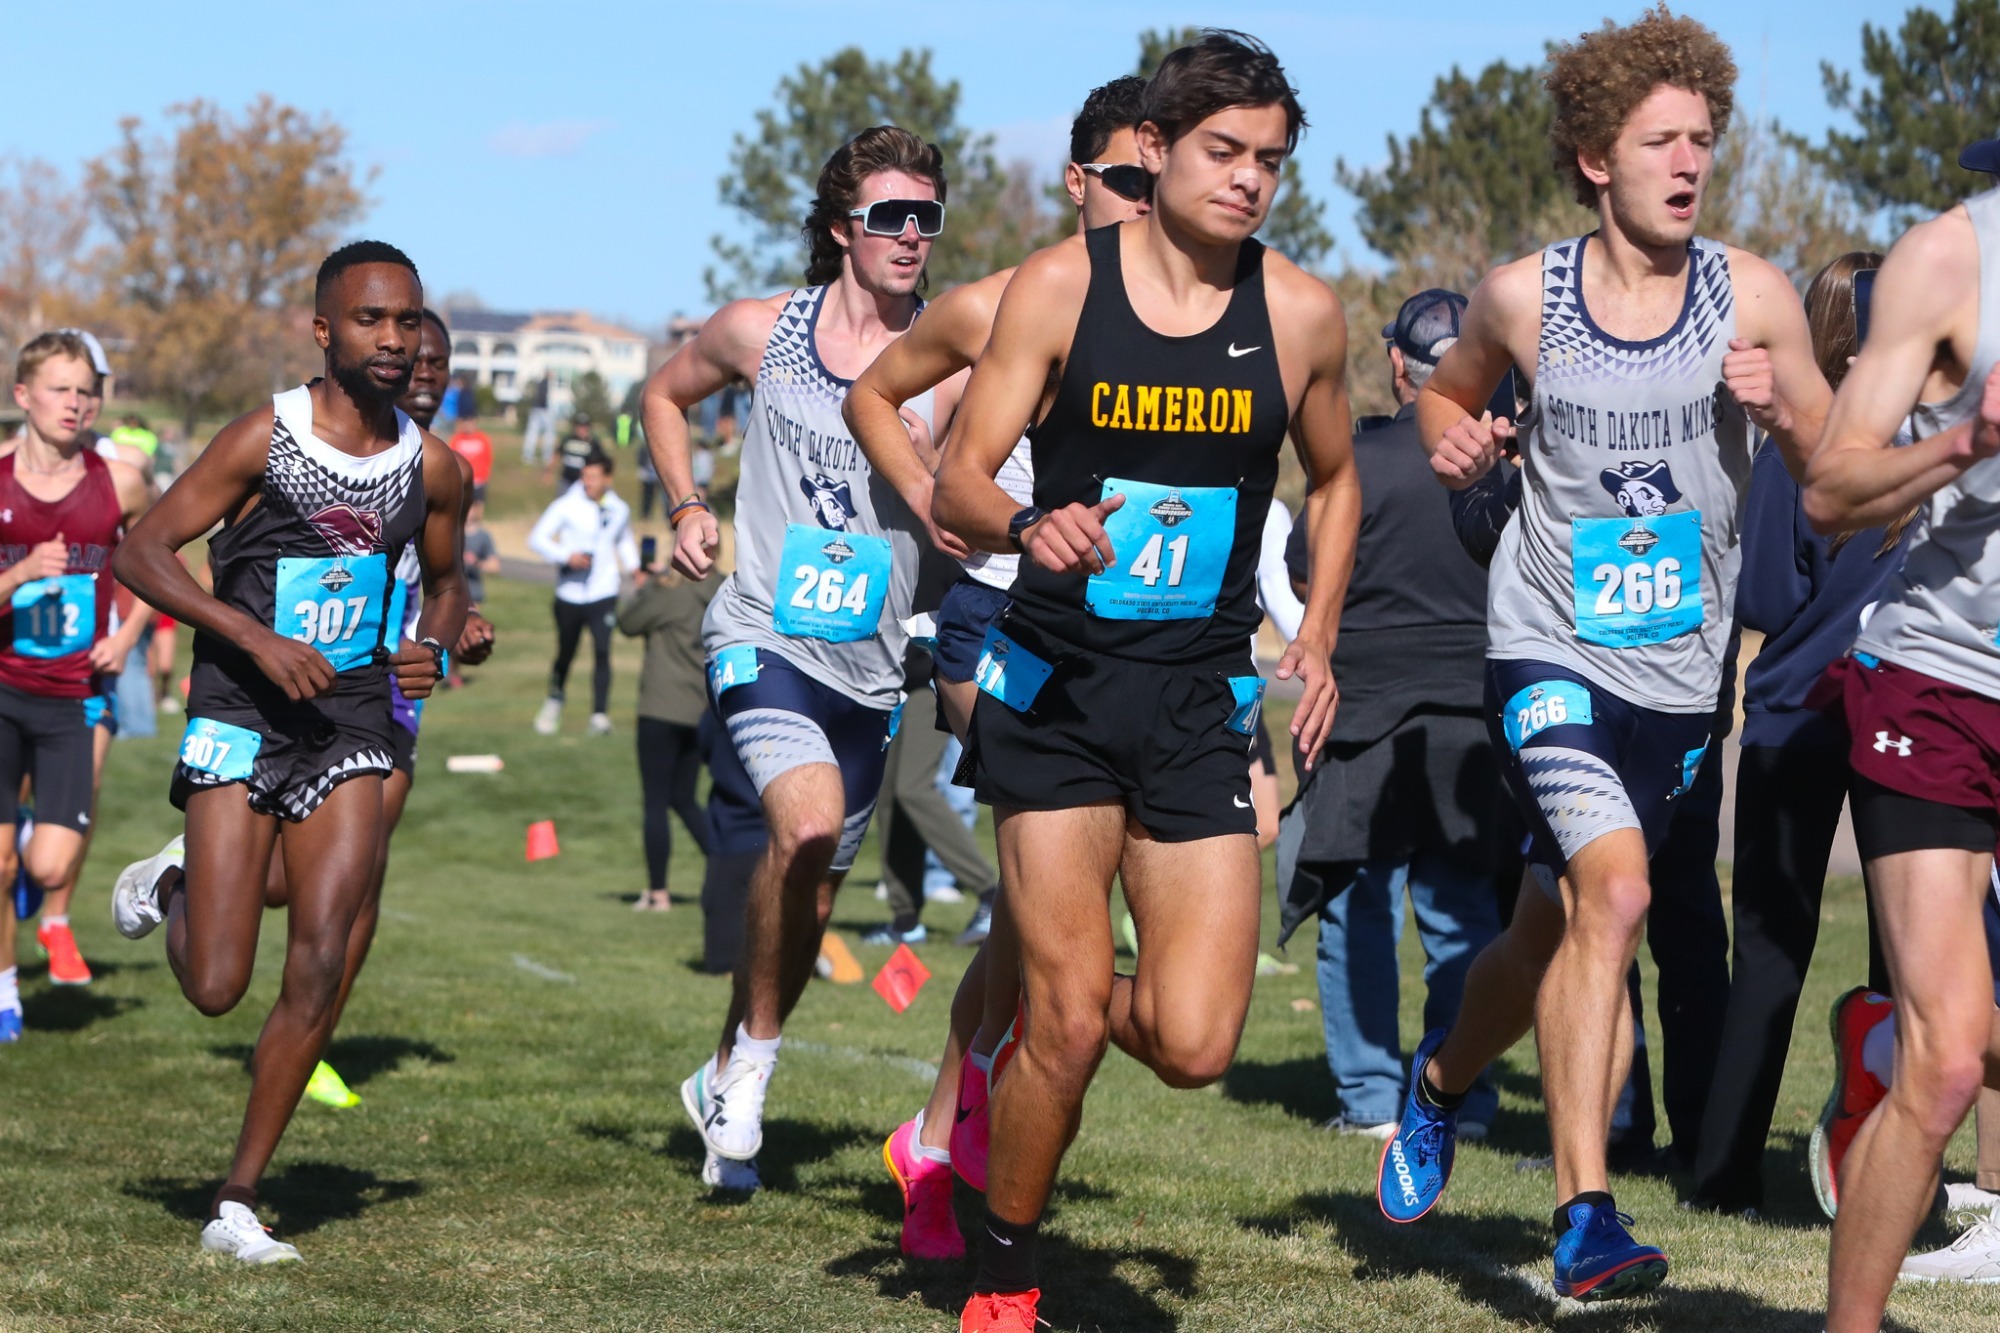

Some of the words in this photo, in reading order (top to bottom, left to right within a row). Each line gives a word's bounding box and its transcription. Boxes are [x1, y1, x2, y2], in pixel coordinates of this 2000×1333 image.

[1092, 382, 1252, 433] CAMERON
[1549, 394, 1597, 447] SOUTH
[1607, 409, 1671, 450] DAKOTA
[767, 404, 803, 457] SOUTH
[808, 430, 857, 472] DAKOTA
[1150, 507, 1192, 517] CHAMPIONSHIPS
[1129, 533, 1190, 587] 41
[790, 564, 870, 616] 264
[1593, 557, 1682, 615] 266
[28, 602, 80, 637] 112
[293, 596, 368, 645] 307
[976, 651, 1007, 692] 41
[1518, 695, 1568, 741] 266
[181, 734, 232, 772] 307
[1392, 1140, 1420, 1207] BROOKS
